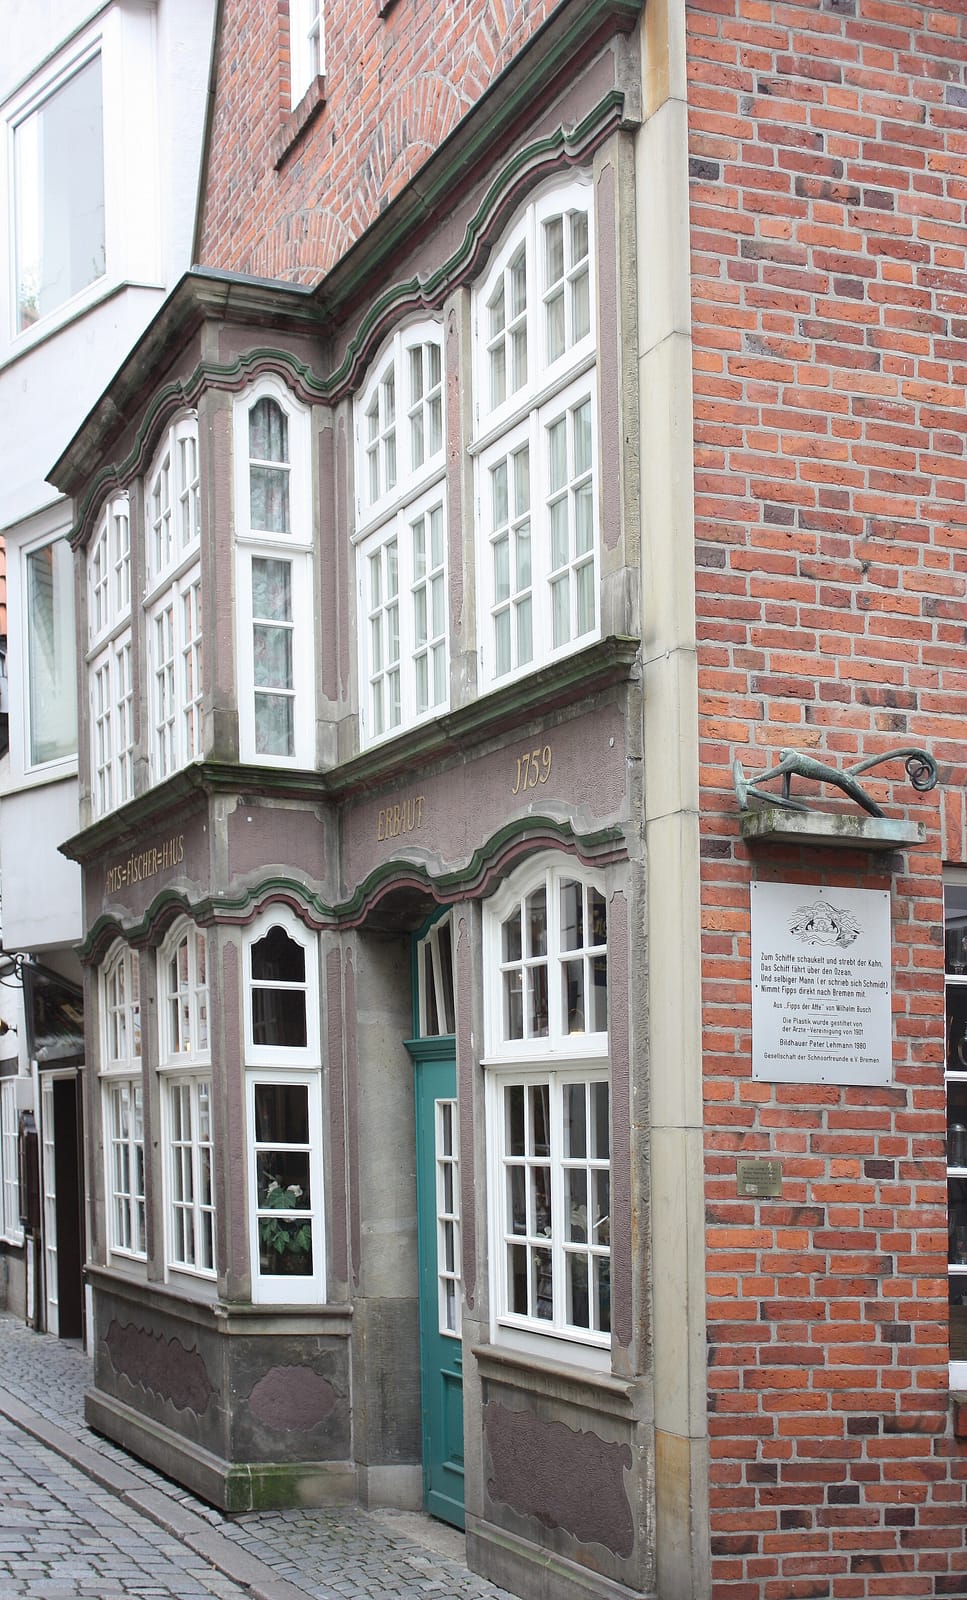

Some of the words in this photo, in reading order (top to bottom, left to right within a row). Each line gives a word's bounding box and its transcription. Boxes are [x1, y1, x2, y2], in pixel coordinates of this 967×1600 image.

[377, 795, 425, 842] ERBAUT
[761, 952, 774, 961] Zum
[797, 955, 825, 964] schaukelt
[827, 957, 837, 965] und
[839, 958, 856, 966] strebt
[857, 959, 867, 967] der
[761, 963, 772, 971] Das
[774, 964, 790, 973] Schiff
[822, 966, 833, 975] den
[761, 974, 772, 982] Und
[774, 975, 797, 985] selbiger
[799, 976, 815, 985] Mann
[828, 978, 849, 986] schrieb
[851, 979, 863, 987] sich
[761, 985, 780, 993] Nimmt
[782, 985, 797, 995] Fipps
[817, 987, 831, 996] nach
[833, 988, 854, 997] Bremen
[836, 1004, 856, 1012] Wilhelm
[857, 1005, 872, 1013] Busch
[780, 1039, 808, 1047] Bildhauer
[809, 1040, 825, 1048] Peter
[826, 1041, 854, 1049] Lehmann
[764, 1052, 797, 1060] Gesellschaft
[860, 1056, 880, 1064] Bremen
